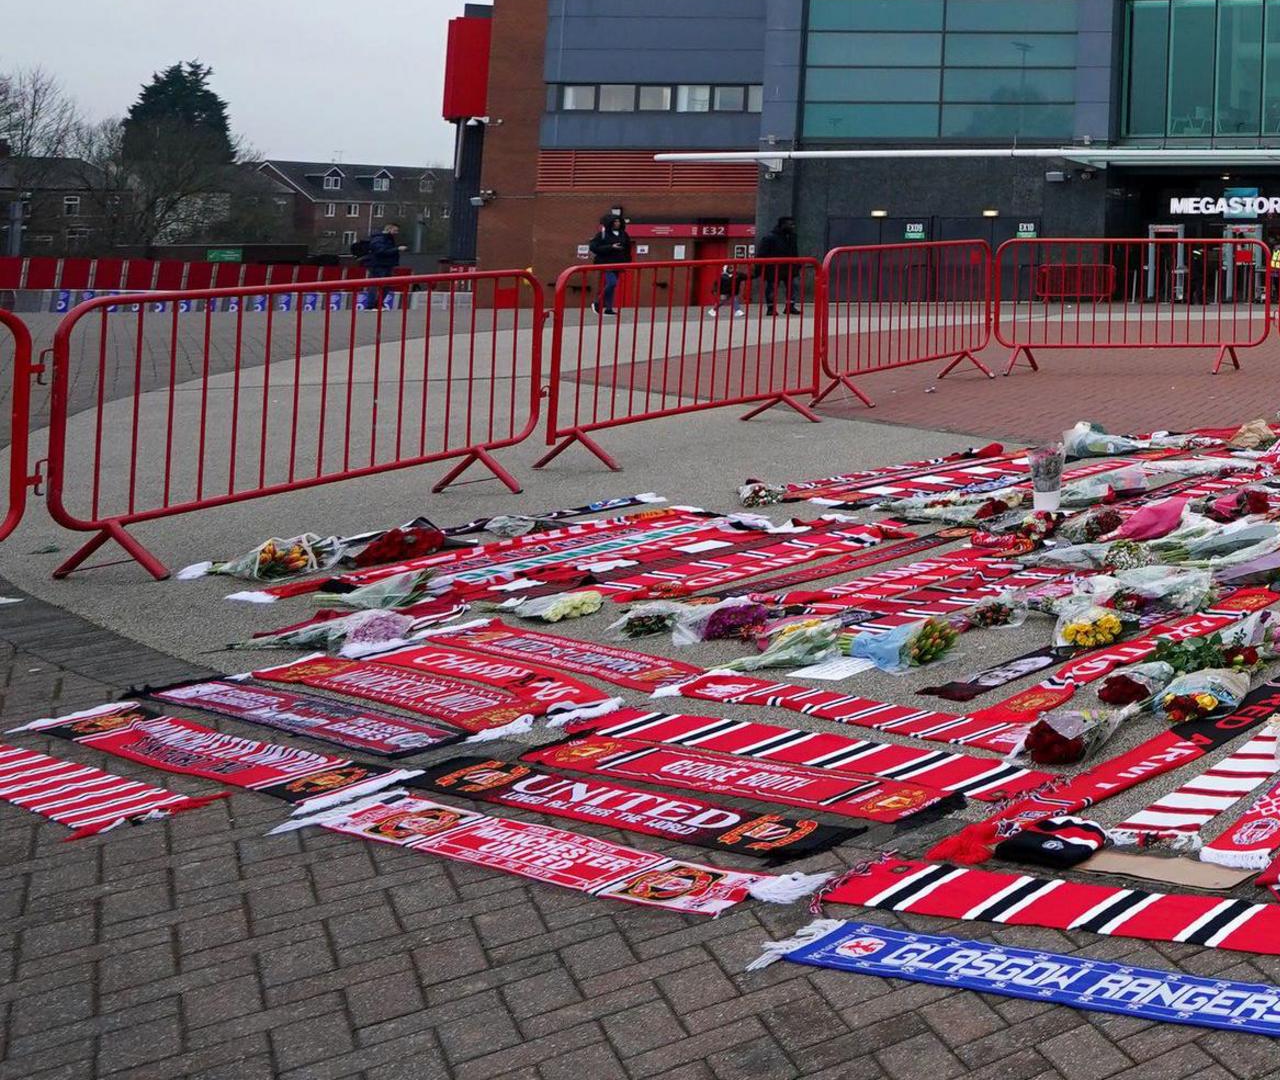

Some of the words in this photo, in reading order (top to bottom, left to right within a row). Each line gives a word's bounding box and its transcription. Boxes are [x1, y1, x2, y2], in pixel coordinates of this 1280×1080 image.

[702, 226, 725, 236] E32
[906, 223, 923, 233] EX09
[1018, 222, 1035, 233] EX10
[138, 719, 261, 763] MANCHESTER
[242, 740, 330, 774] UNITED
[659, 758, 741, 783] GEORGE
[736, 770, 817, 794] BOOTH
[510, 774, 744, 830] UNITED
[616, 809, 648, 824] THE
[471, 827, 632, 870] MANCHESTER
[477, 842, 575, 871] UNITED
[880, 942, 1090, 991] GLASGOW
